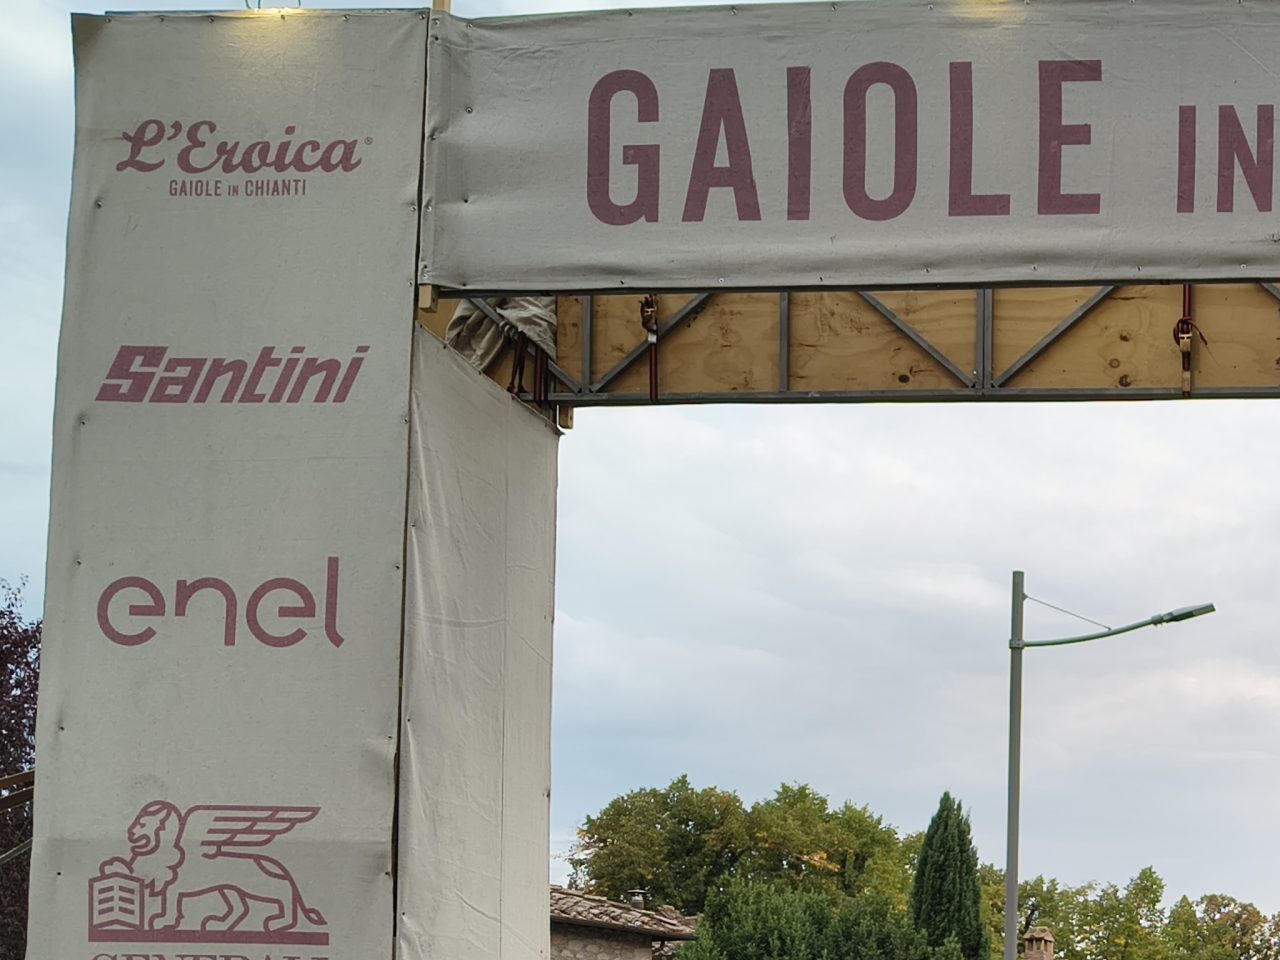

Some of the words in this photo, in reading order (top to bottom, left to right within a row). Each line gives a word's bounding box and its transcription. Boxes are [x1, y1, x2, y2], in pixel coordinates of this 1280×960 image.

[117, 119, 363, 174] L'Eroica
[587, 59, 1102, 225] GAIOLE
[1176, 103, 1276, 214] IN
[169, 180, 222, 197] GAIOLE
[227, 184, 239, 197] IN
[244, 179, 308, 197] CHIANTI
[96, 345, 370, 404] Santini
[97, 556, 345, 648] enel
